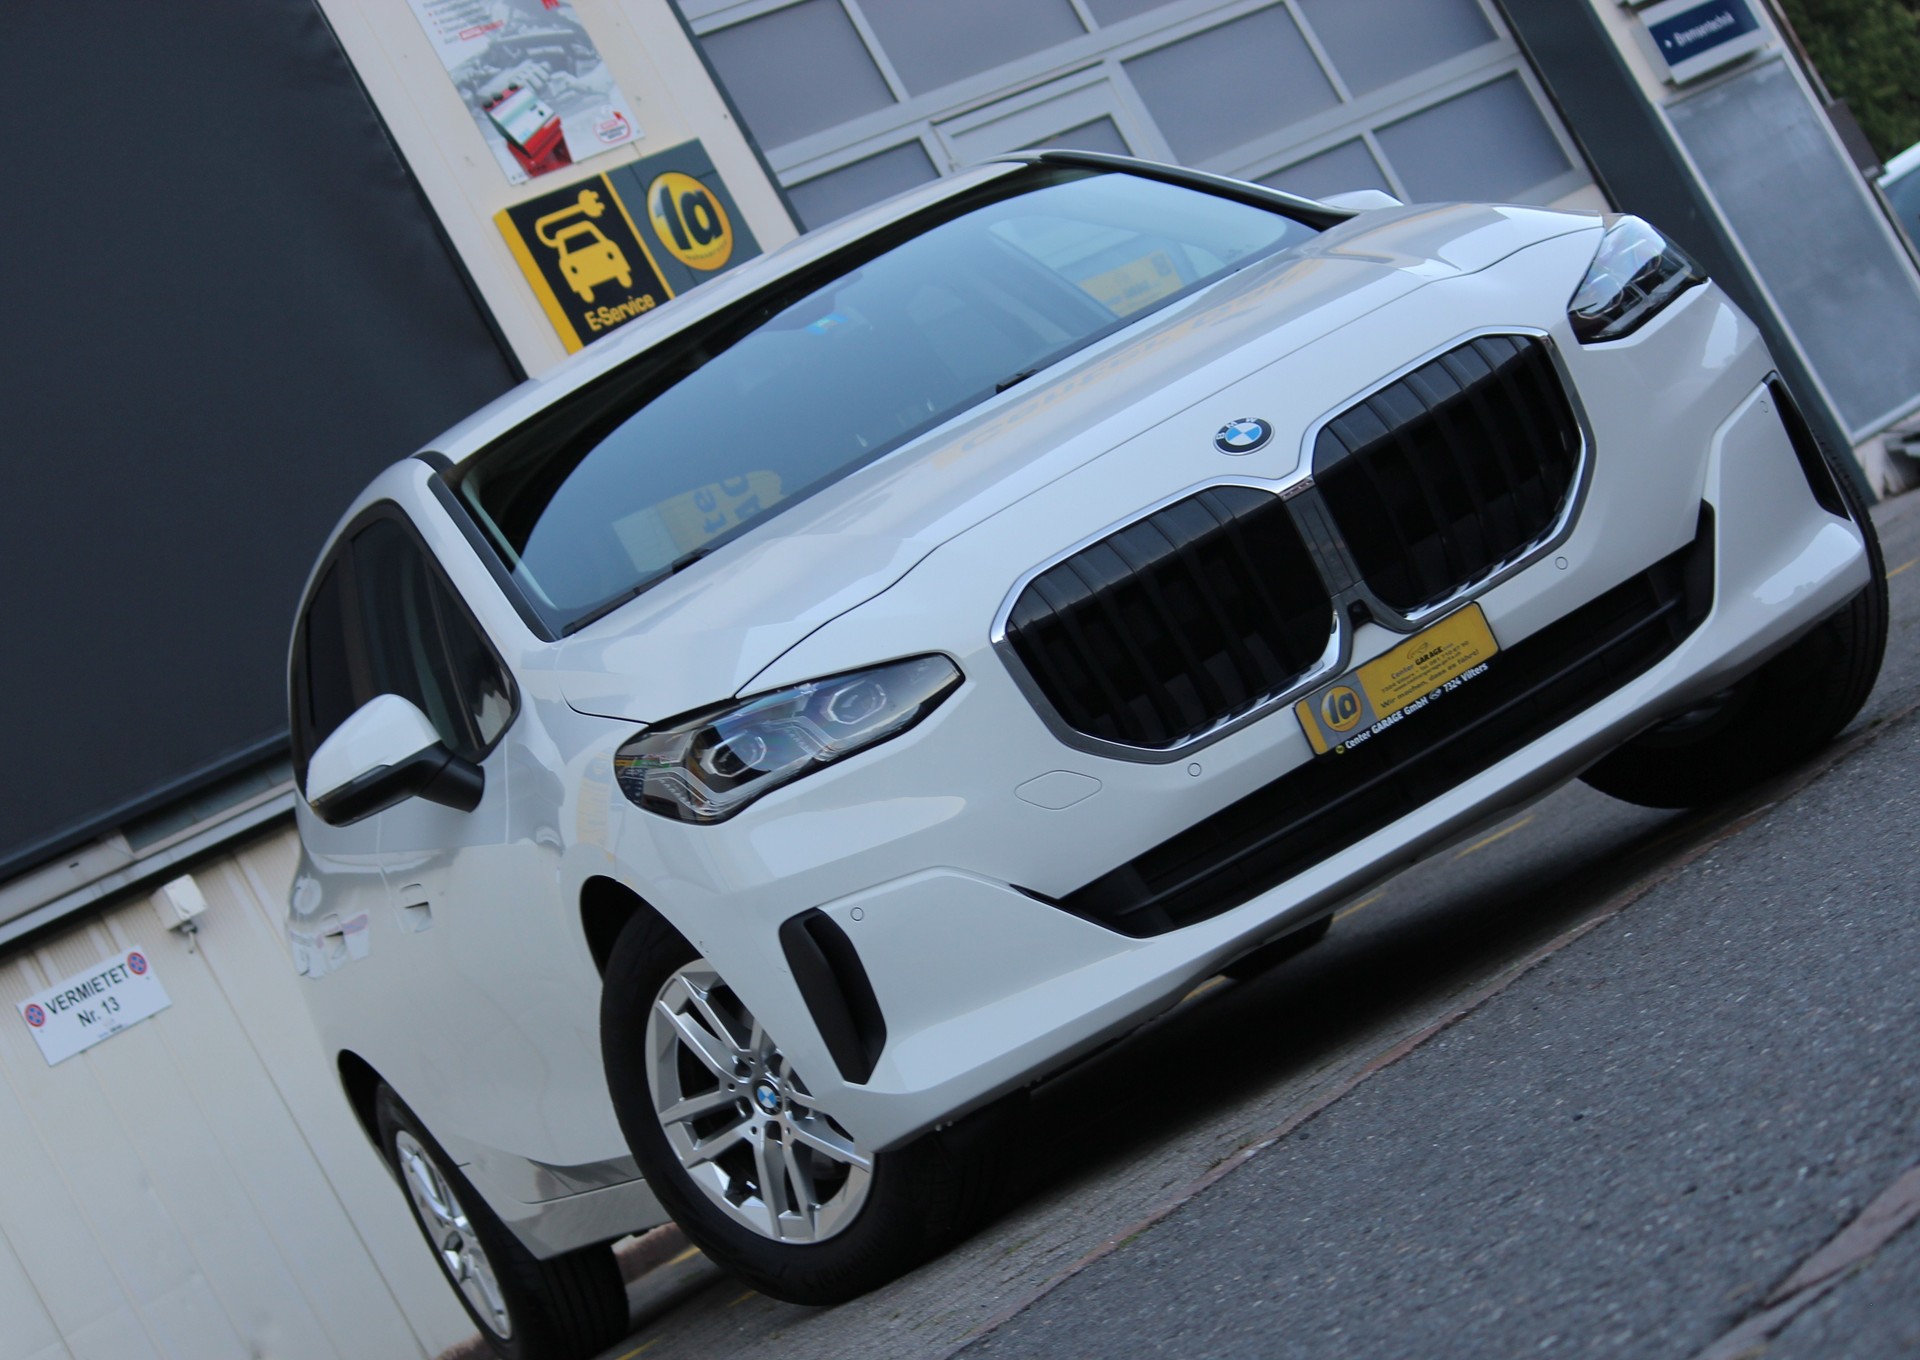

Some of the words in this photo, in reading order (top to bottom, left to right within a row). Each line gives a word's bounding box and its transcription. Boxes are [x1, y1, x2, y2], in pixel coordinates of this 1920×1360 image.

[584, 294, 656, 332] E-Service
[1415, 646, 1443, 666] GARAGE
[1345, 731, 1371, 749] Center
[1371, 711, 1404, 734] GARAGE
[1403, 696, 1429, 715] GmbH
[1443, 677, 1462, 692] 7324
[1460, 663, 1489, 681] Vilters
[44, 963, 129, 1015] VERMIETET
[77, 1009, 102, 1028] Nr.
[102, 996, 120, 1015] 13
